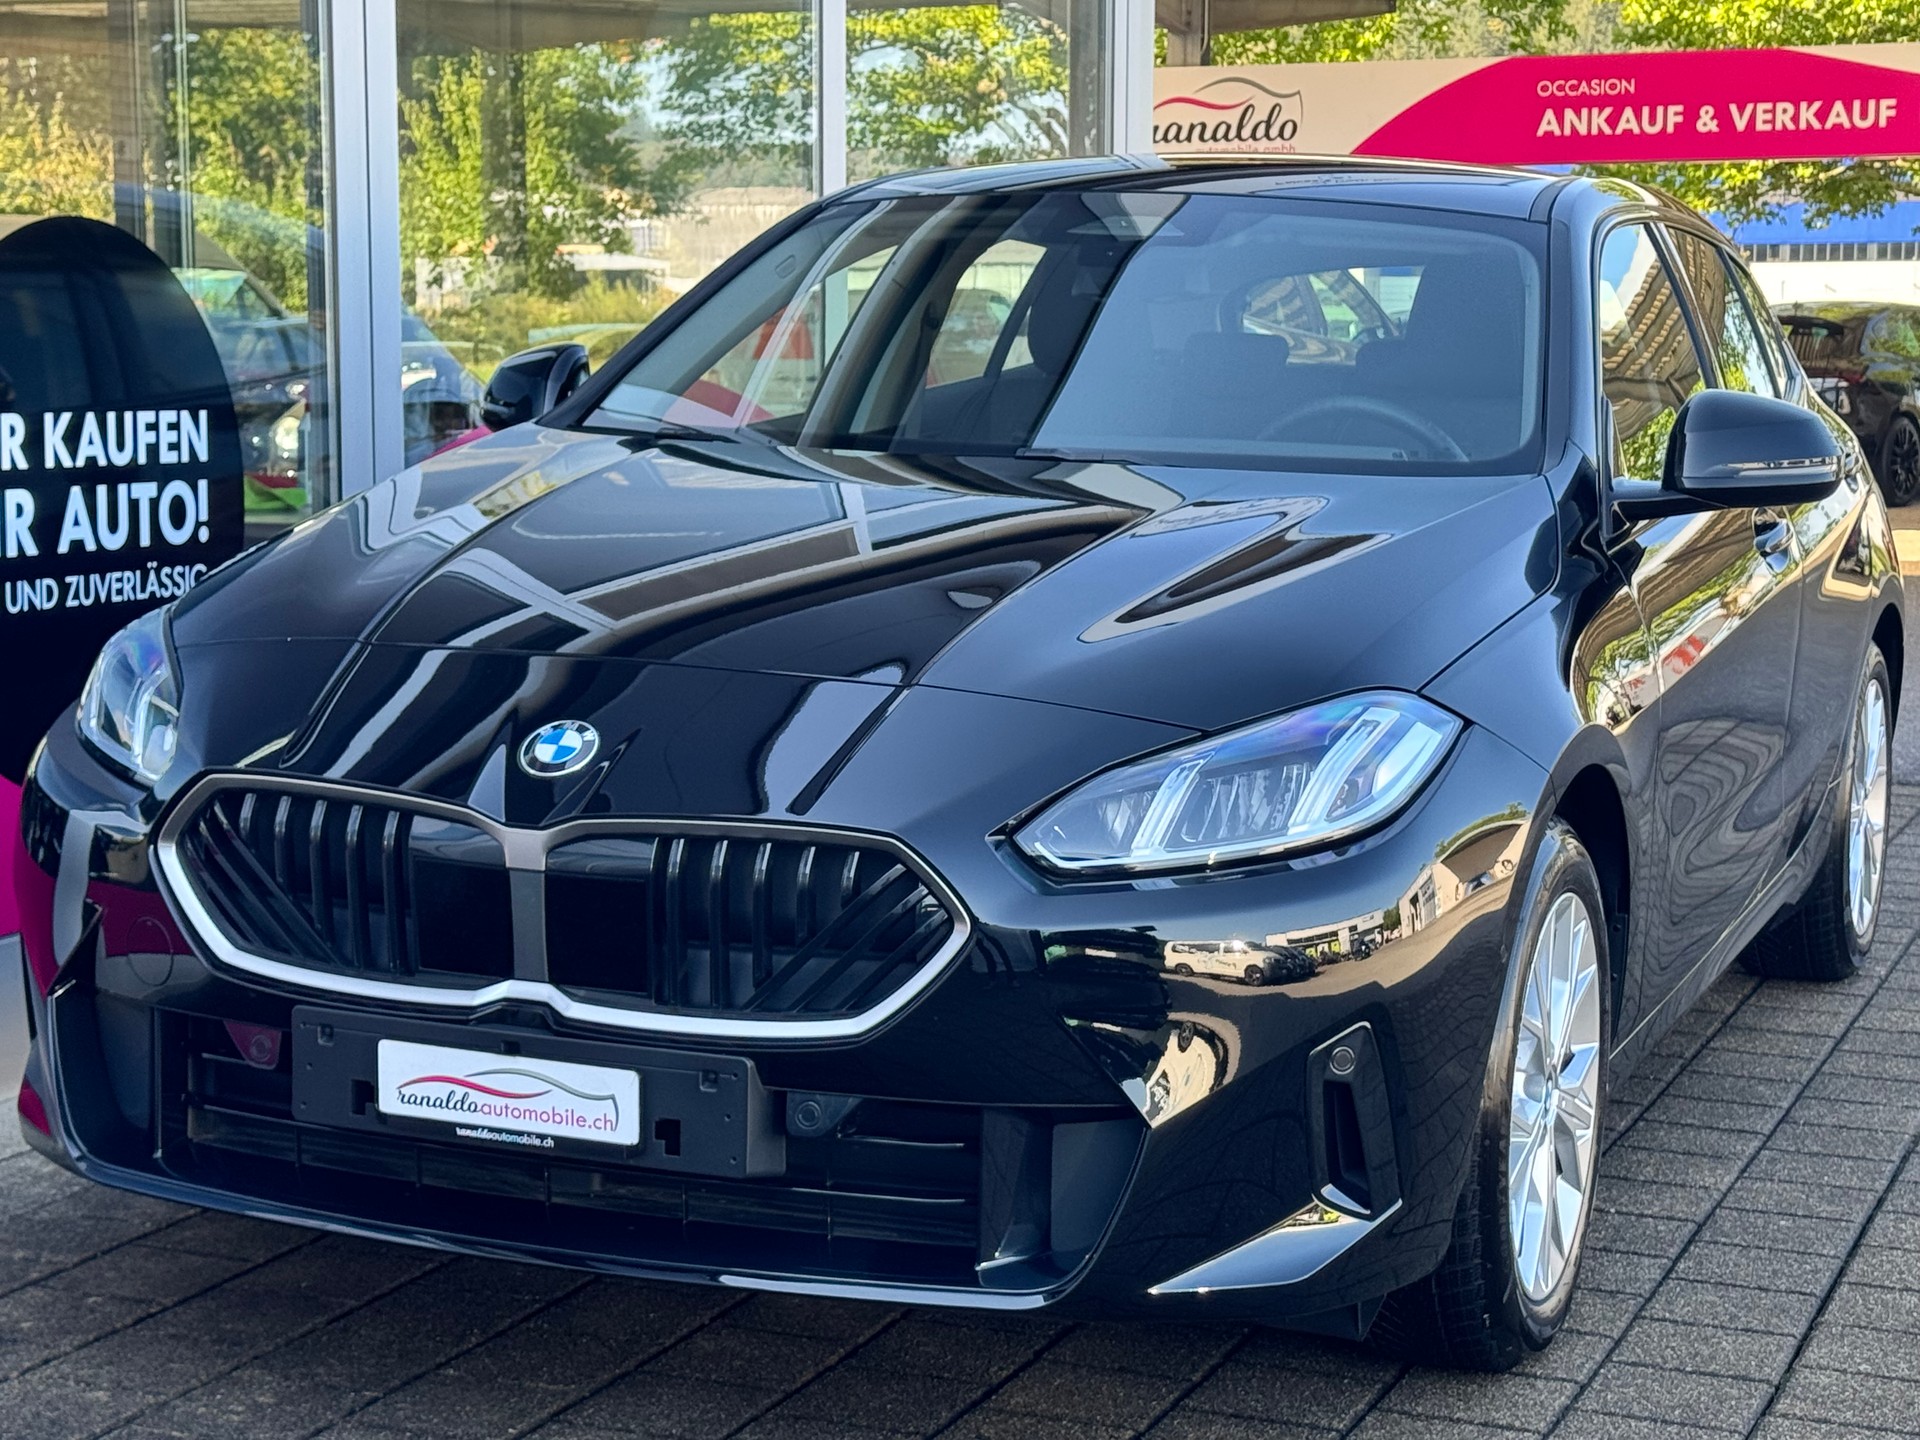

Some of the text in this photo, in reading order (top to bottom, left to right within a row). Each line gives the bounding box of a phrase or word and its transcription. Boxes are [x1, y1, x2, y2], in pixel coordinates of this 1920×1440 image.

[1536, 78, 1636, 97] OCCASION
[1536, 98, 1898, 137] ANKAUF & VERKAUF
[43, 409, 209, 469] KAUFEN
[57, 478, 210, 555] AUTO!
[5, 577, 59, 614] UND
